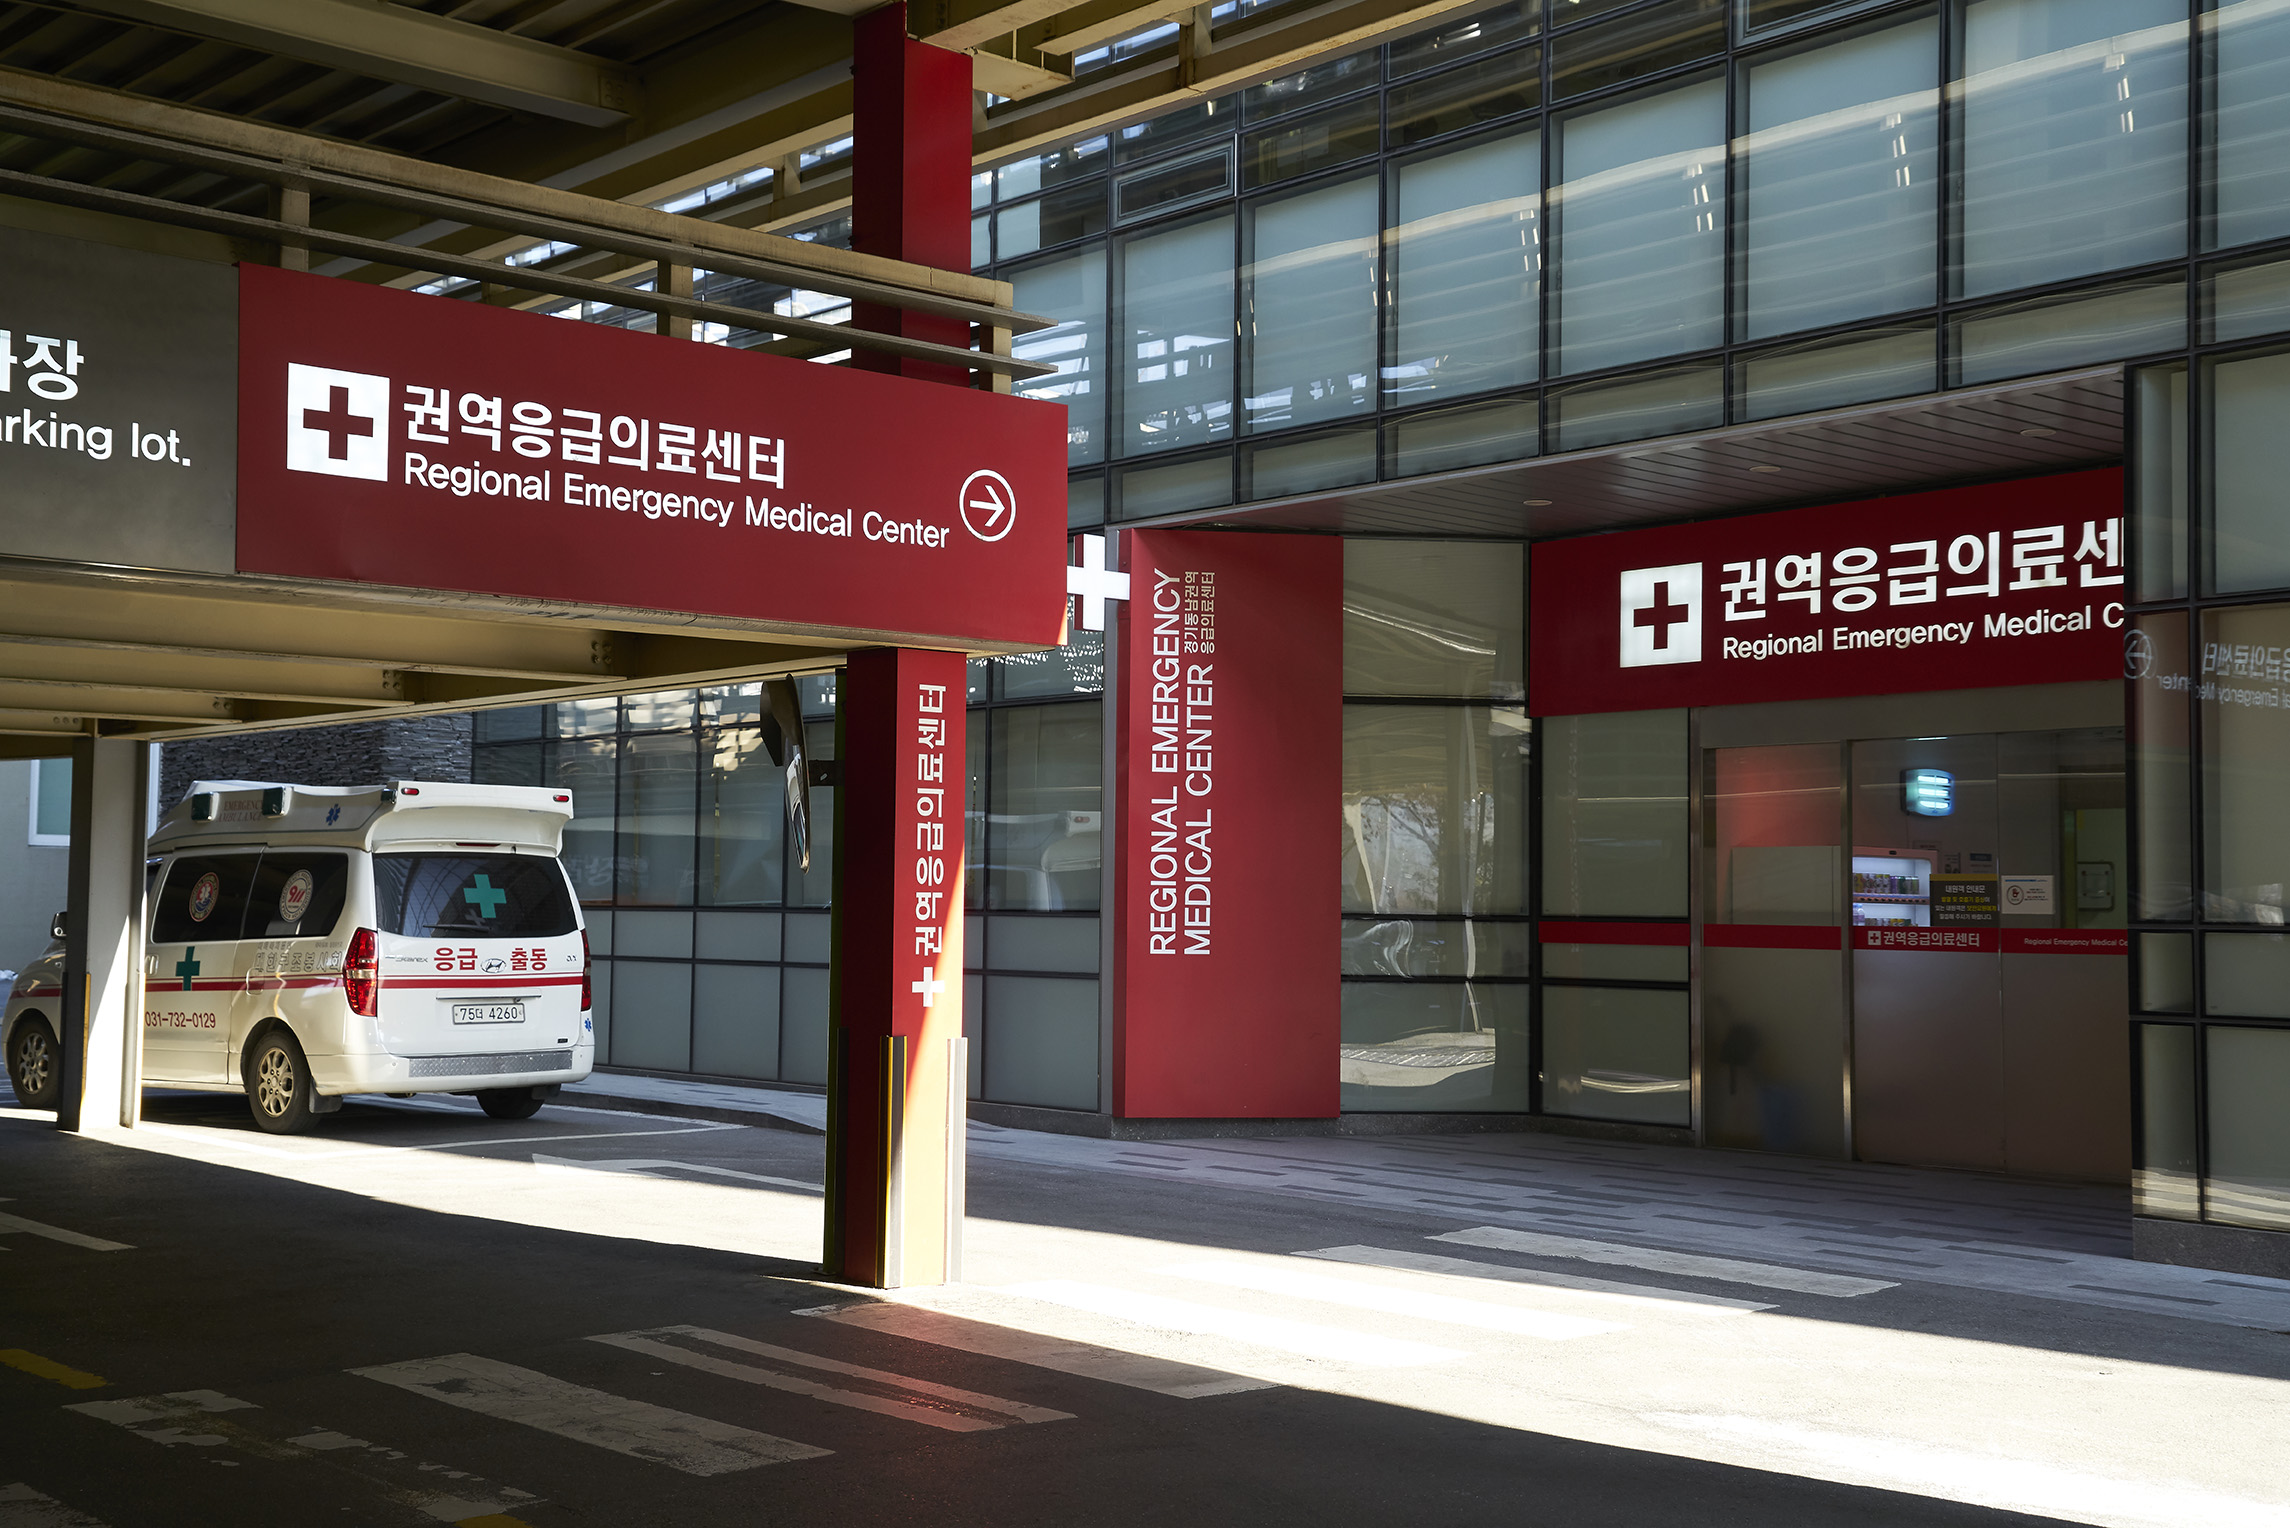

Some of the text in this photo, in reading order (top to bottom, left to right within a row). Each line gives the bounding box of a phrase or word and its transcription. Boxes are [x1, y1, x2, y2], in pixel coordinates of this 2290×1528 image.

[0, 408, 191, 467] rking lot.
[403, 384, 786, 490] 권역응급의료센터
[404, 452, 950, 549] Regional Emergency Medical Center
[1184, 570, 1199, 654] 경기동남권역
[1200, 571, 1216, 655] 응급의료센터
[1722, 629, 1823, 661] Regional
[1832, 621, 1974, 649] Emergency
[1984, 605, 2092, 638] Medical
[1149, 567, 1181, 955] REGIONAL EMERGENCY
[915, 684, 947, 957] 권역응급의료센터
[1184, 664, 1214, 955] MEDICAL CENTER
[434, 947, 548, 971] 응급 출동
[1883, 931, 1980, 947] 권역응급의료센터
[2024, 938, 2052, 946] Regional
[2053, 938, 2090, 947] Emergency
[145, 1011, 216, 1028] 031-732-0129
[488, 1007, 518, 1020] 4260
